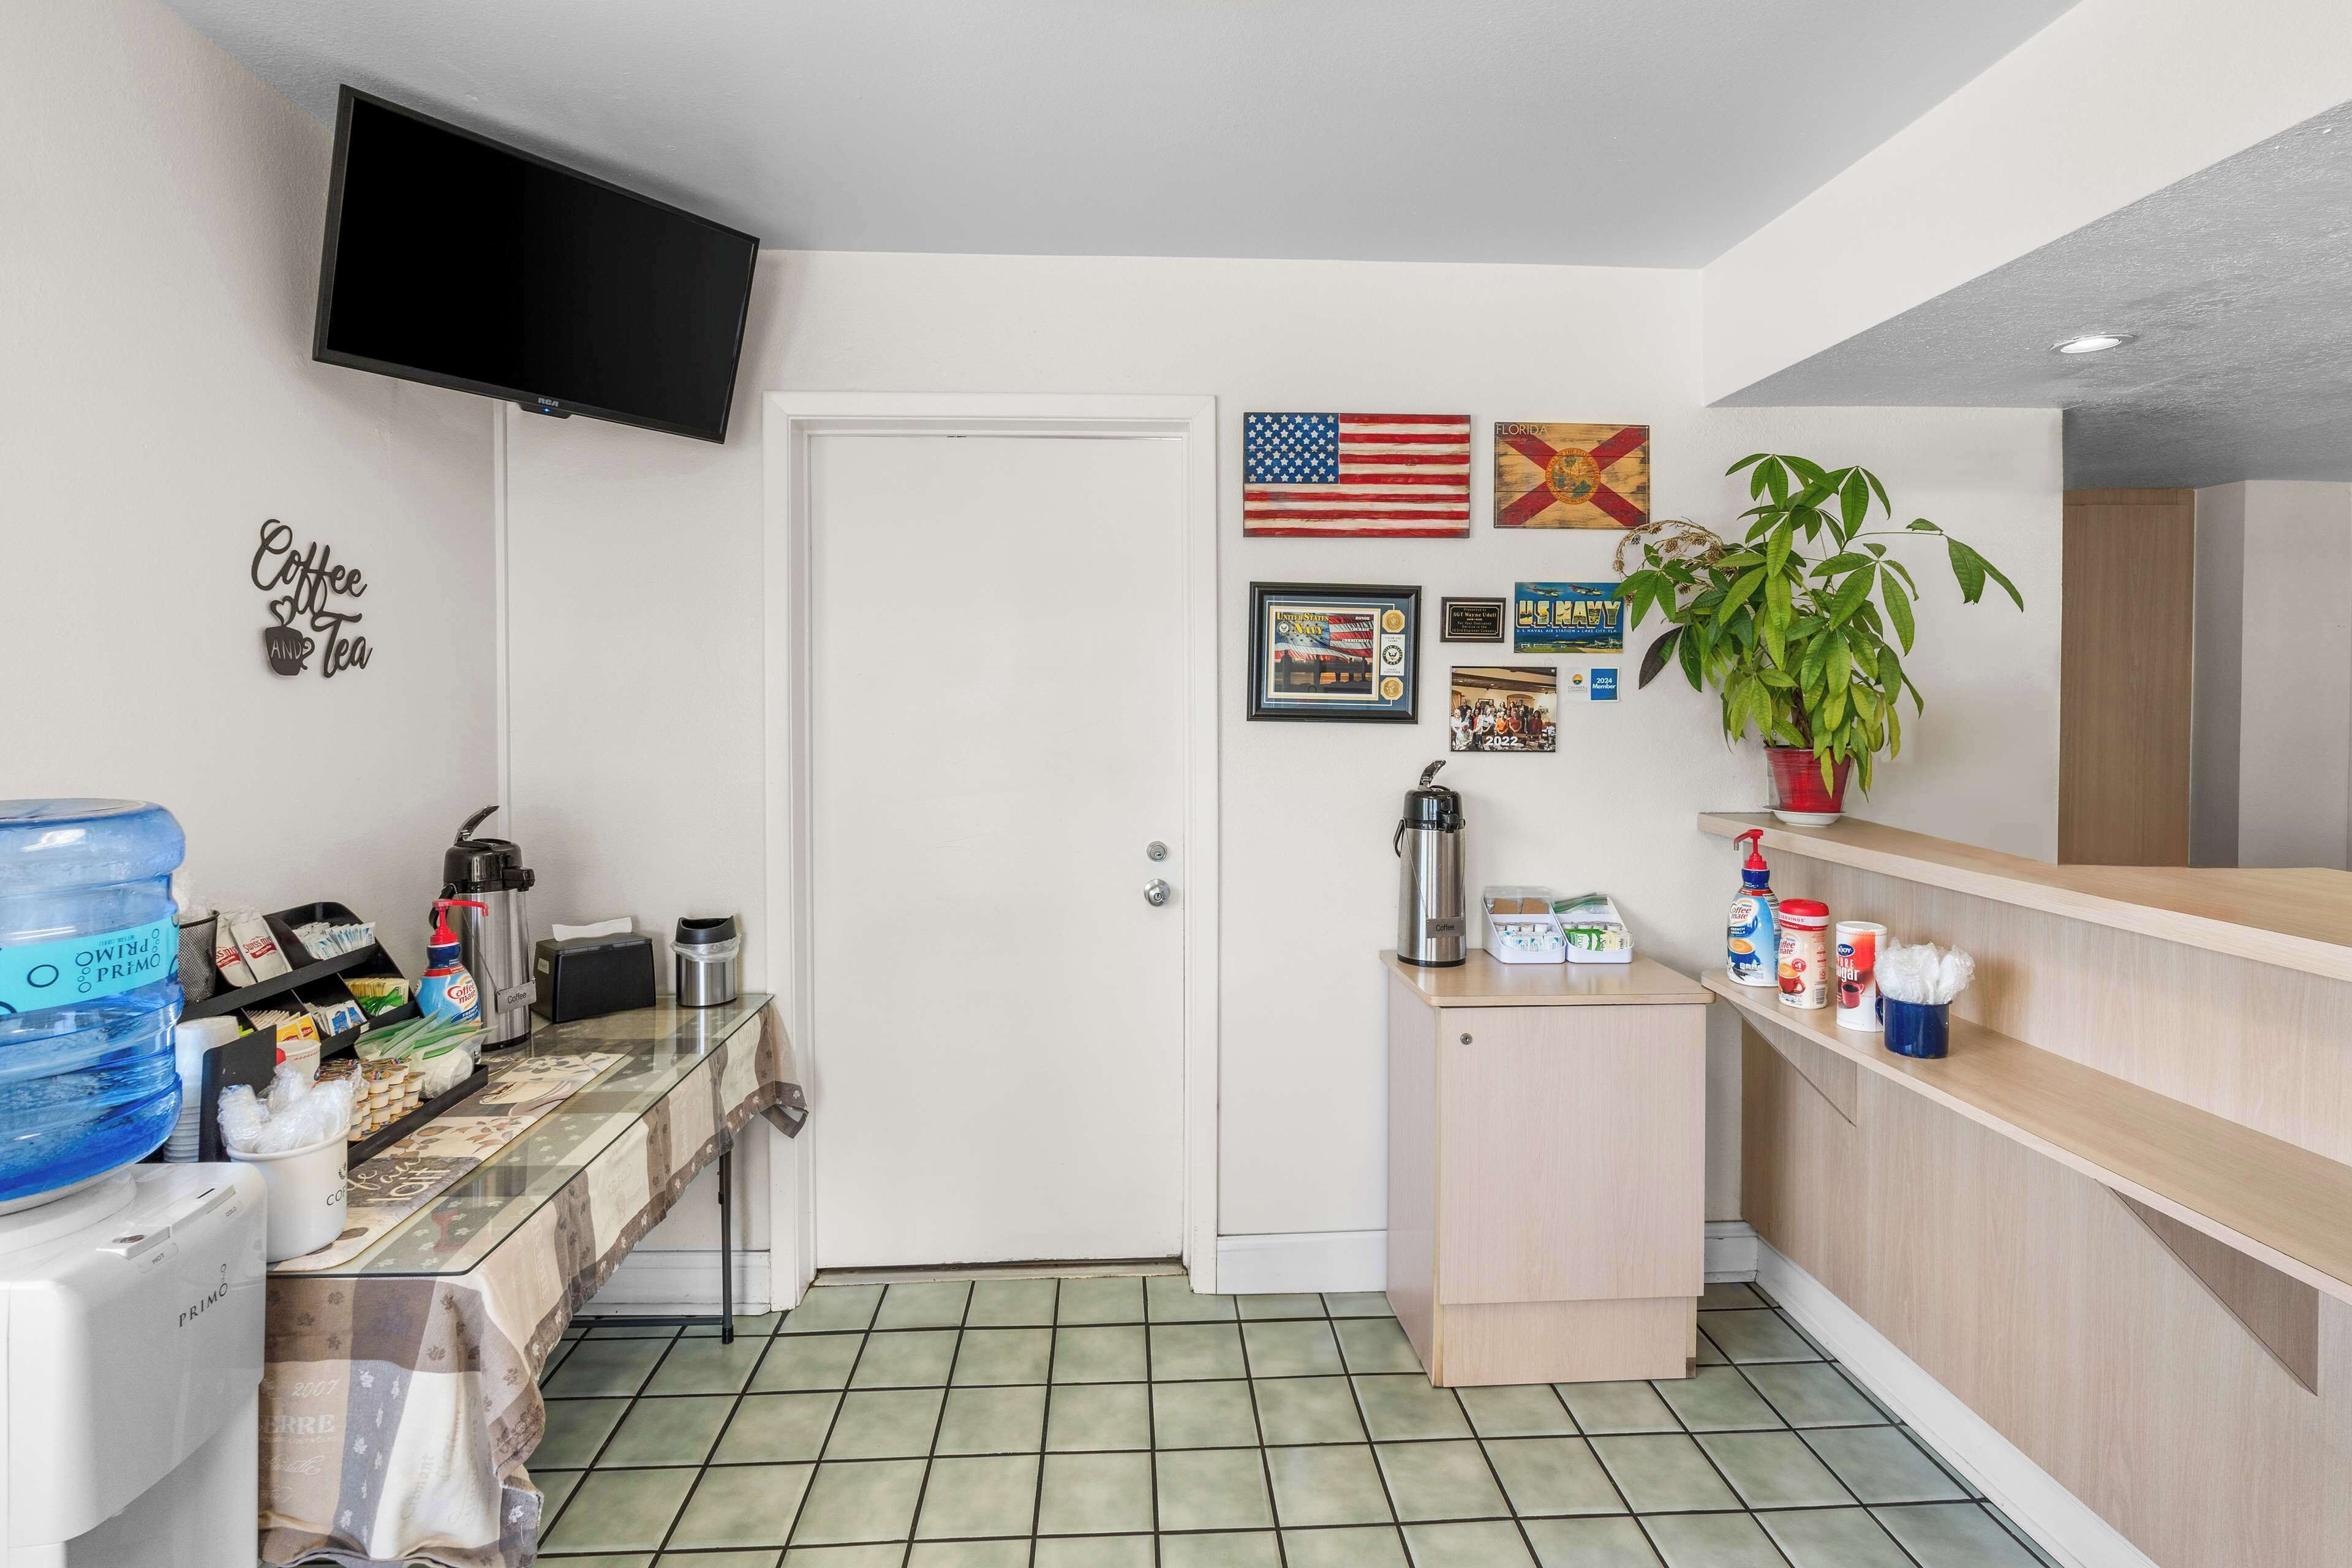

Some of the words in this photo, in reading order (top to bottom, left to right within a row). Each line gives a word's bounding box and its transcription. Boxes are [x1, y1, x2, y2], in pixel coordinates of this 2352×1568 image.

[538, 397, 559, 407] RCA
[1496, 424, 1548, 435] FLORIDA
[251, 518, 368, 614] Coffee
[1276, 612, 1303, 620] UNITED
[1303, 612, 1329, 621] STATES
[1551, 600, 1621, 628] NAVY
[1293, 622, 1324, 635] NAVY
[271, 636, 303, 660] AND
[311, 611, 373, 678] Tea
[1485, 736, 1518, 746] 2022
[1730, 903, 1752, 914] Coffee
[1436, 923, 1455, 932] Coffee
[75, 938, 149, 967] PRIMO
[447, 982, 475, 999] Coffee
[459, 989, 476, 1005] mate
[507, 992, 527, 1004] Coffee
[379, 1156, 421, 1184] au
[366, 1167, 451, 1202] lait
[225, 1206, 237, 1217] COLD
[152, 1253, 165, 1265] HOT
[179, 1282, 228, 1328] PRIMO
[292, 1379, 339, 1398] 2007
